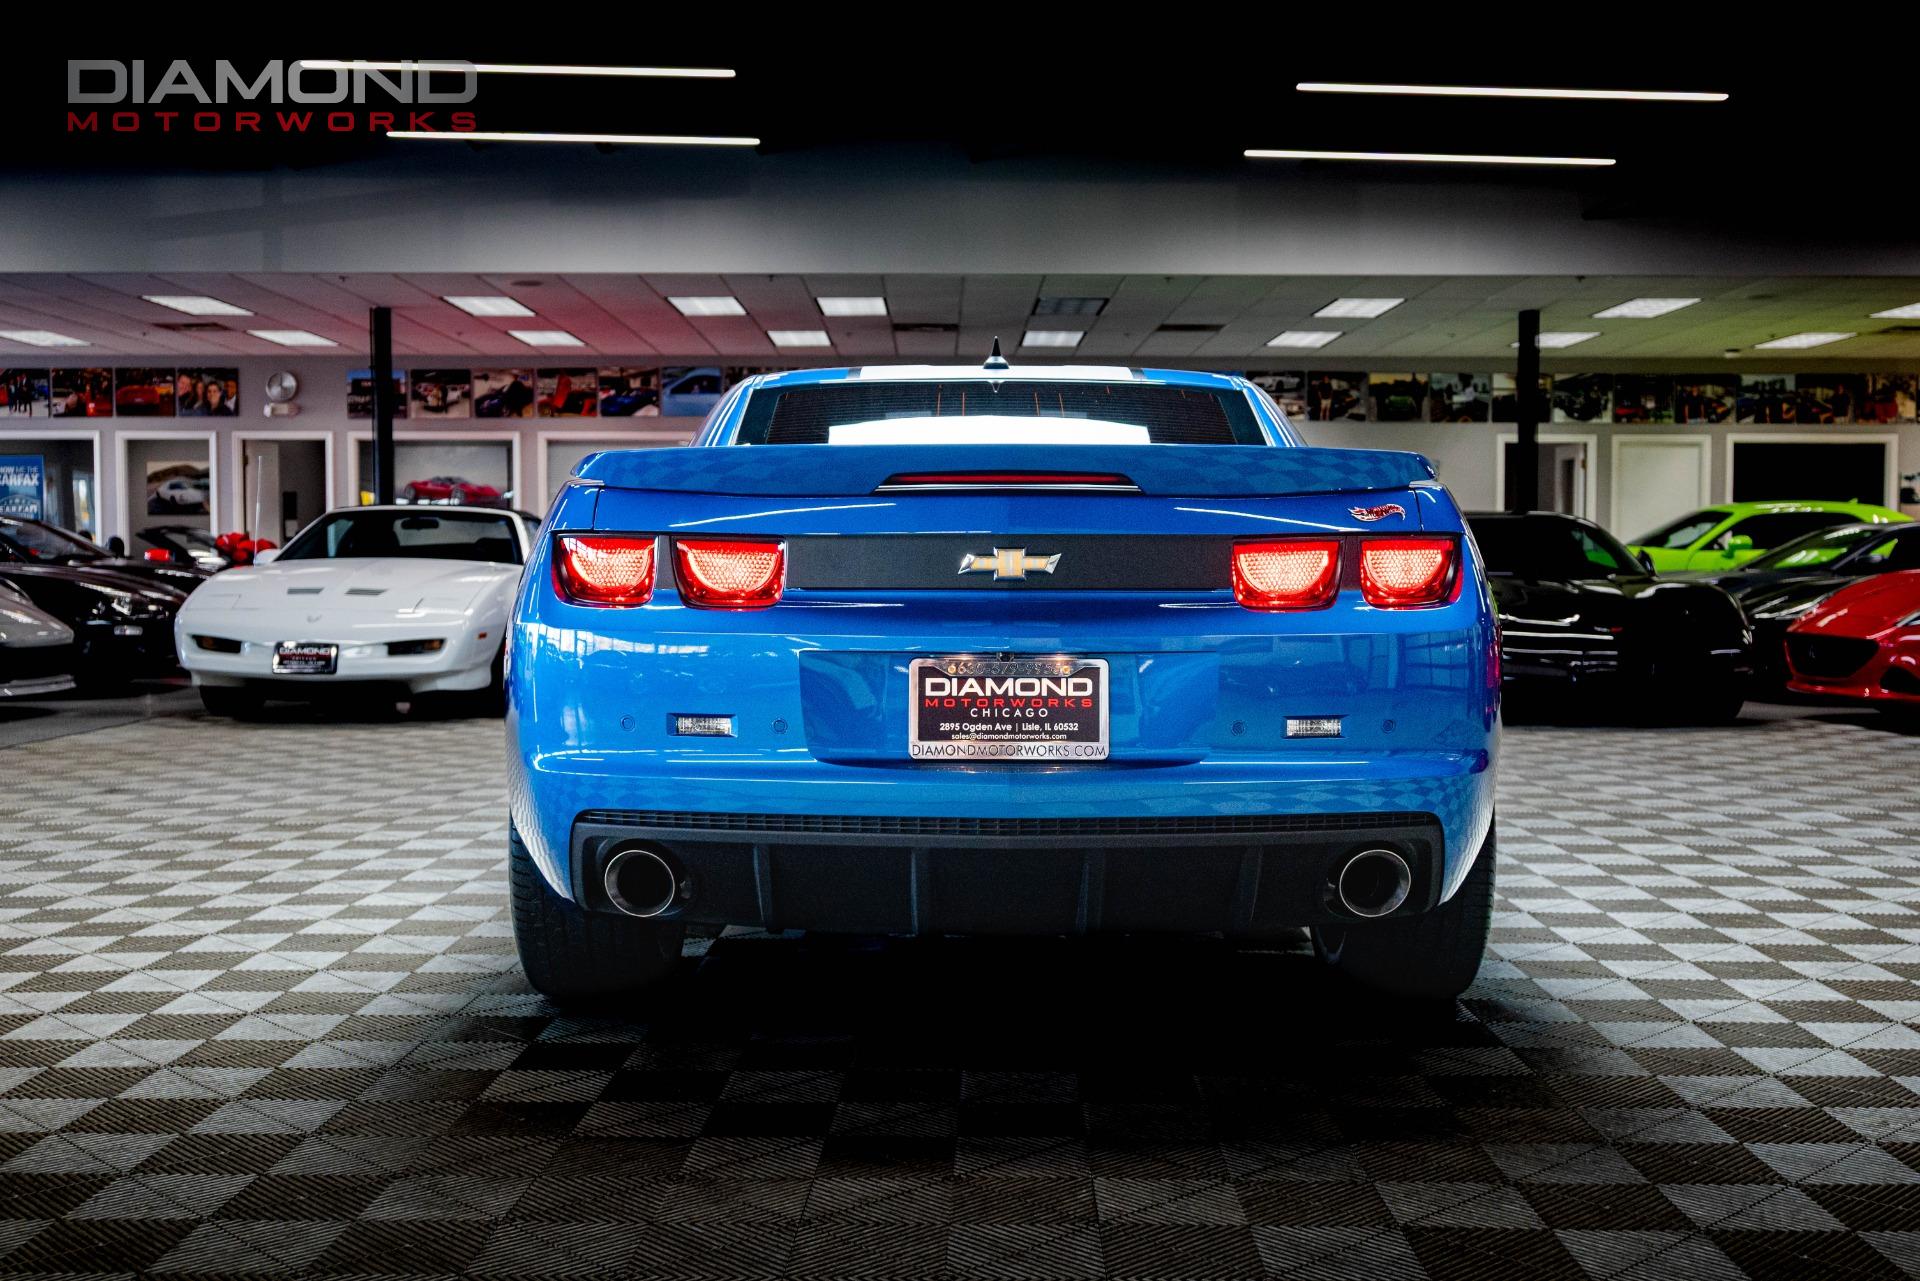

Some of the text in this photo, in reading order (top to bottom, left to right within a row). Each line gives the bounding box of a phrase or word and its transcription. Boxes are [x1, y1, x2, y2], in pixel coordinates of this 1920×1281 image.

[925, 678, 1093, 696] DIAMOND
[925, 698, 1093, 708] MOTORWORKS
[970, 708, 1049, 718] CHICAGO
[939, 722, 960, 731] 2895
[962, 722, 993, 732] Ogden
[994, 722, 1013, 731] Ave
[1021, 722, 1043, 732] Lisle,
[1044, 722, 1052, 731] IL
[1053, 722, 1079, 731] 60532
[951, 732, 1067, 740] sales@diamondmotorworks.com
